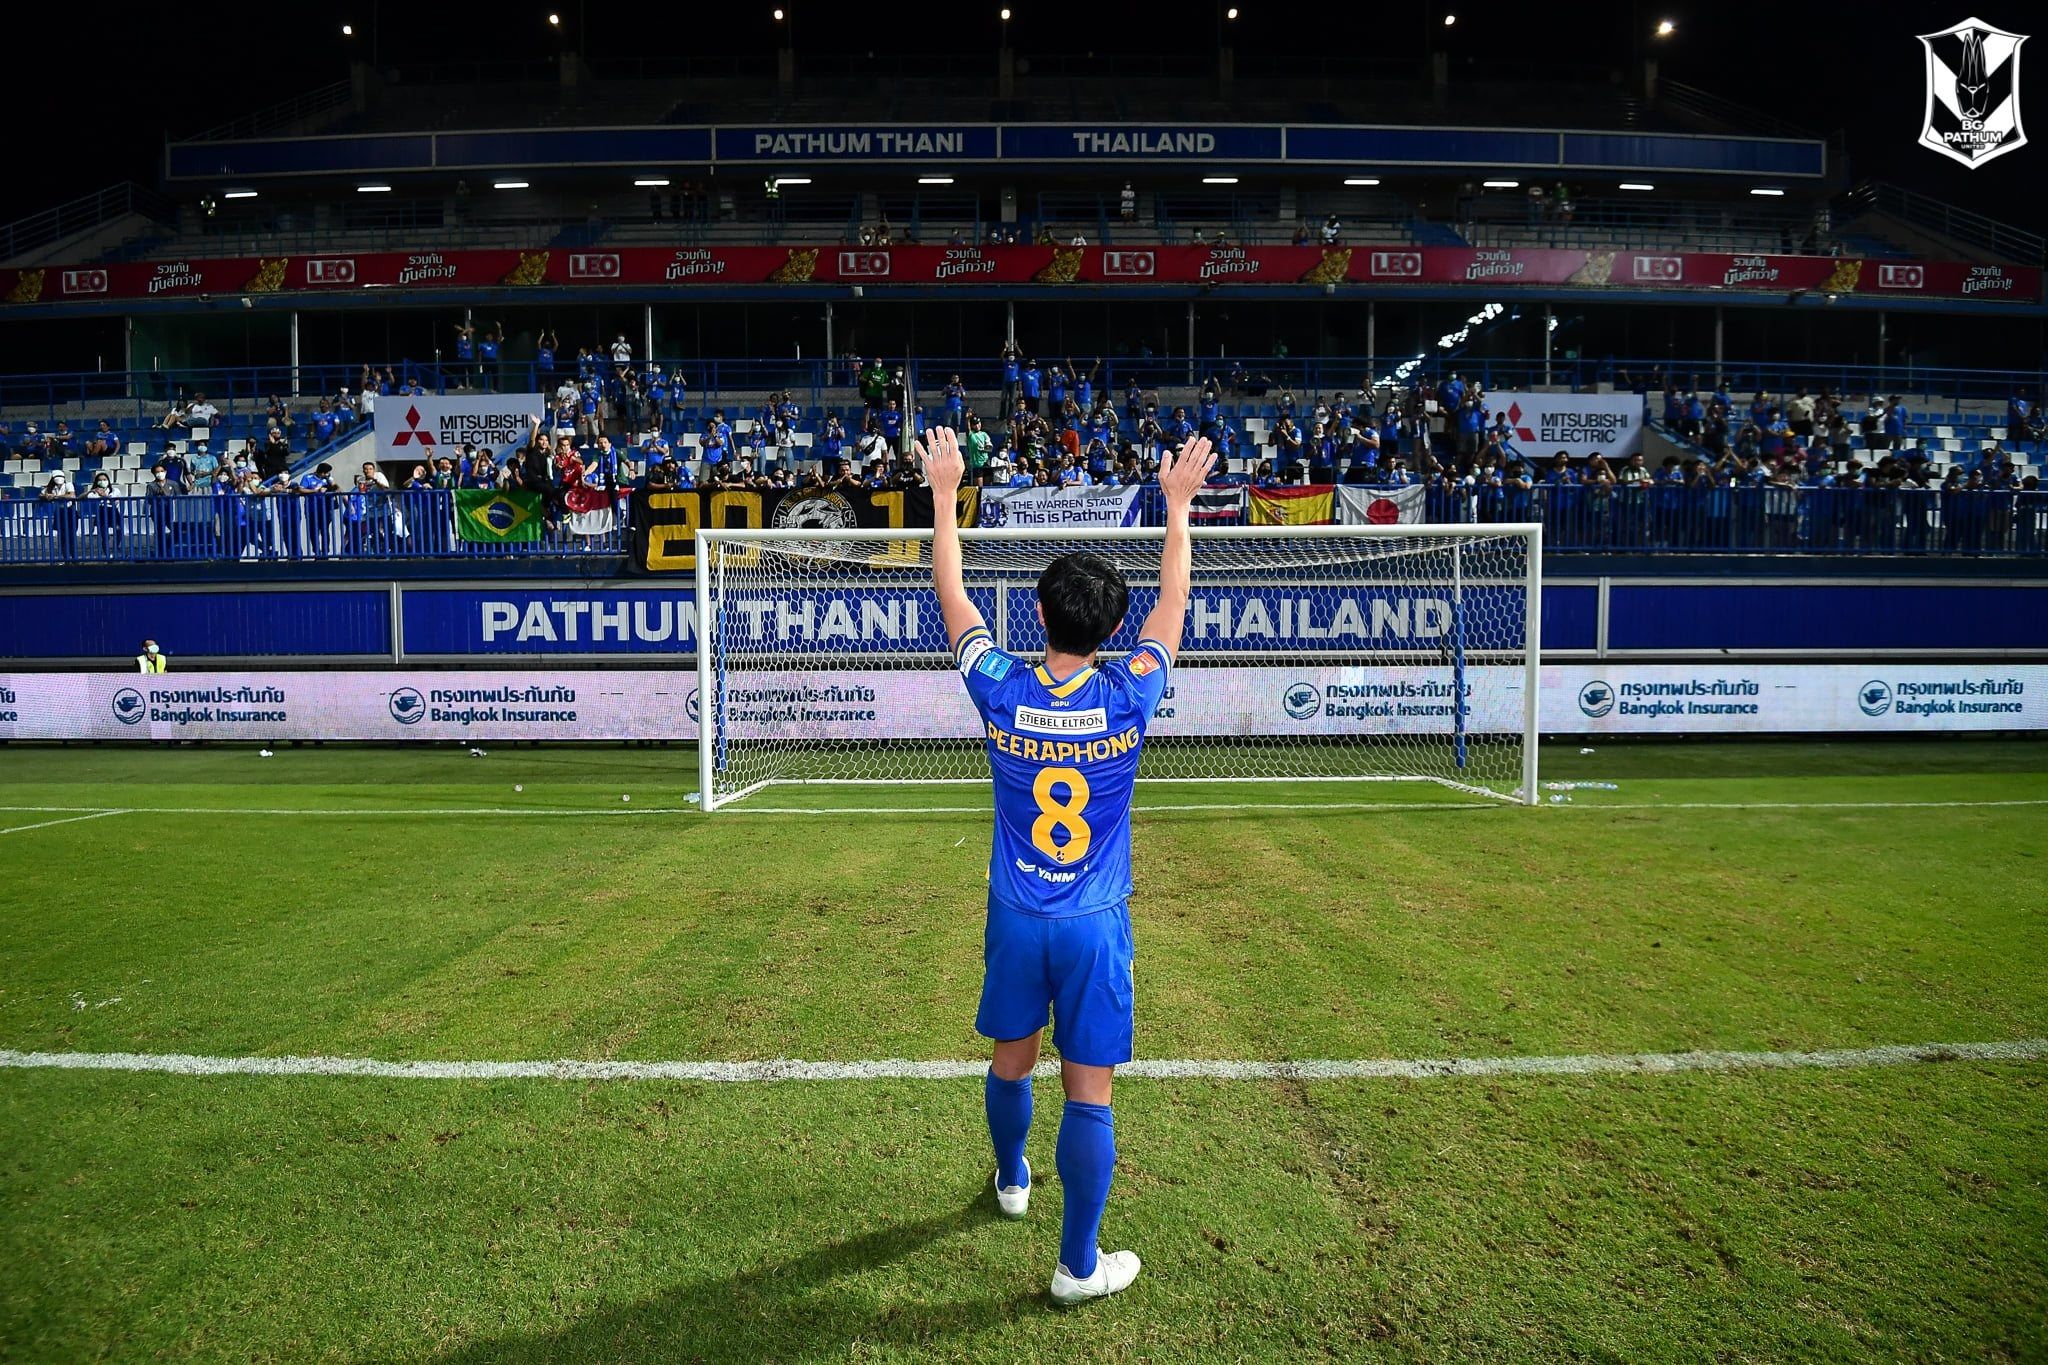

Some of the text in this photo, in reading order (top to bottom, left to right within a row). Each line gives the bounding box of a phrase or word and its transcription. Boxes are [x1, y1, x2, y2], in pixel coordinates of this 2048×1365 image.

[755, 132, 963, 154] PATHUM THANI
[1073, 132, 1216, 153] THAILAND
[307, 260, 355, 283] LEO
[569, 254, 620, 277] LEO
[839, 252, 889, 275] LEO
[1104, 252, 1154, 275] LEO
[1371, 253, 1421, 276] LEO
[1634, 256, 1682, 280] LEO
[63, 270, 107, 293] LEO
[1879, 265, 1923, 288] LEO
[440, 414, 528, 430] MITSUBISHI
[1541, 413, 1627, 428] MITSUBISHI
[441, 430, 517, 445] ELECTRIC
[1541, 428, 1616, 443] ELECTRIC
[1011, 497, 1122, 510] THE WARREN STAND
[1013, 508, 1122, 524] This is Pathum
[737, 600, 918, 640] THANI
[1155, 598, 1452, 638] HAILAND
[150, 686, 285, 708] กรุงเทพประกันภัย
[430, 686, 576, 707] กรุงเทพประกันภัย
[1621, 679, 1759, 701] กรุงเทพประกันภัย
[1897, 679, 2023, 700] กรุงเทพประกันภัย
[151, 707, 286, 725] Bangkok Insurance
[431, 707, 577, 725] Bangkok Insurance
[1619, 700, 1758, 718] Bangkok Insurance
[1896, 699, 2022, 717] Bangkok Insurance
[1019, 713, 1103, 727] STIEBEL ELTRON
[987, 721, 1139, 762] PEERAPHONG
[1032, 767, 1091, 864] 8
